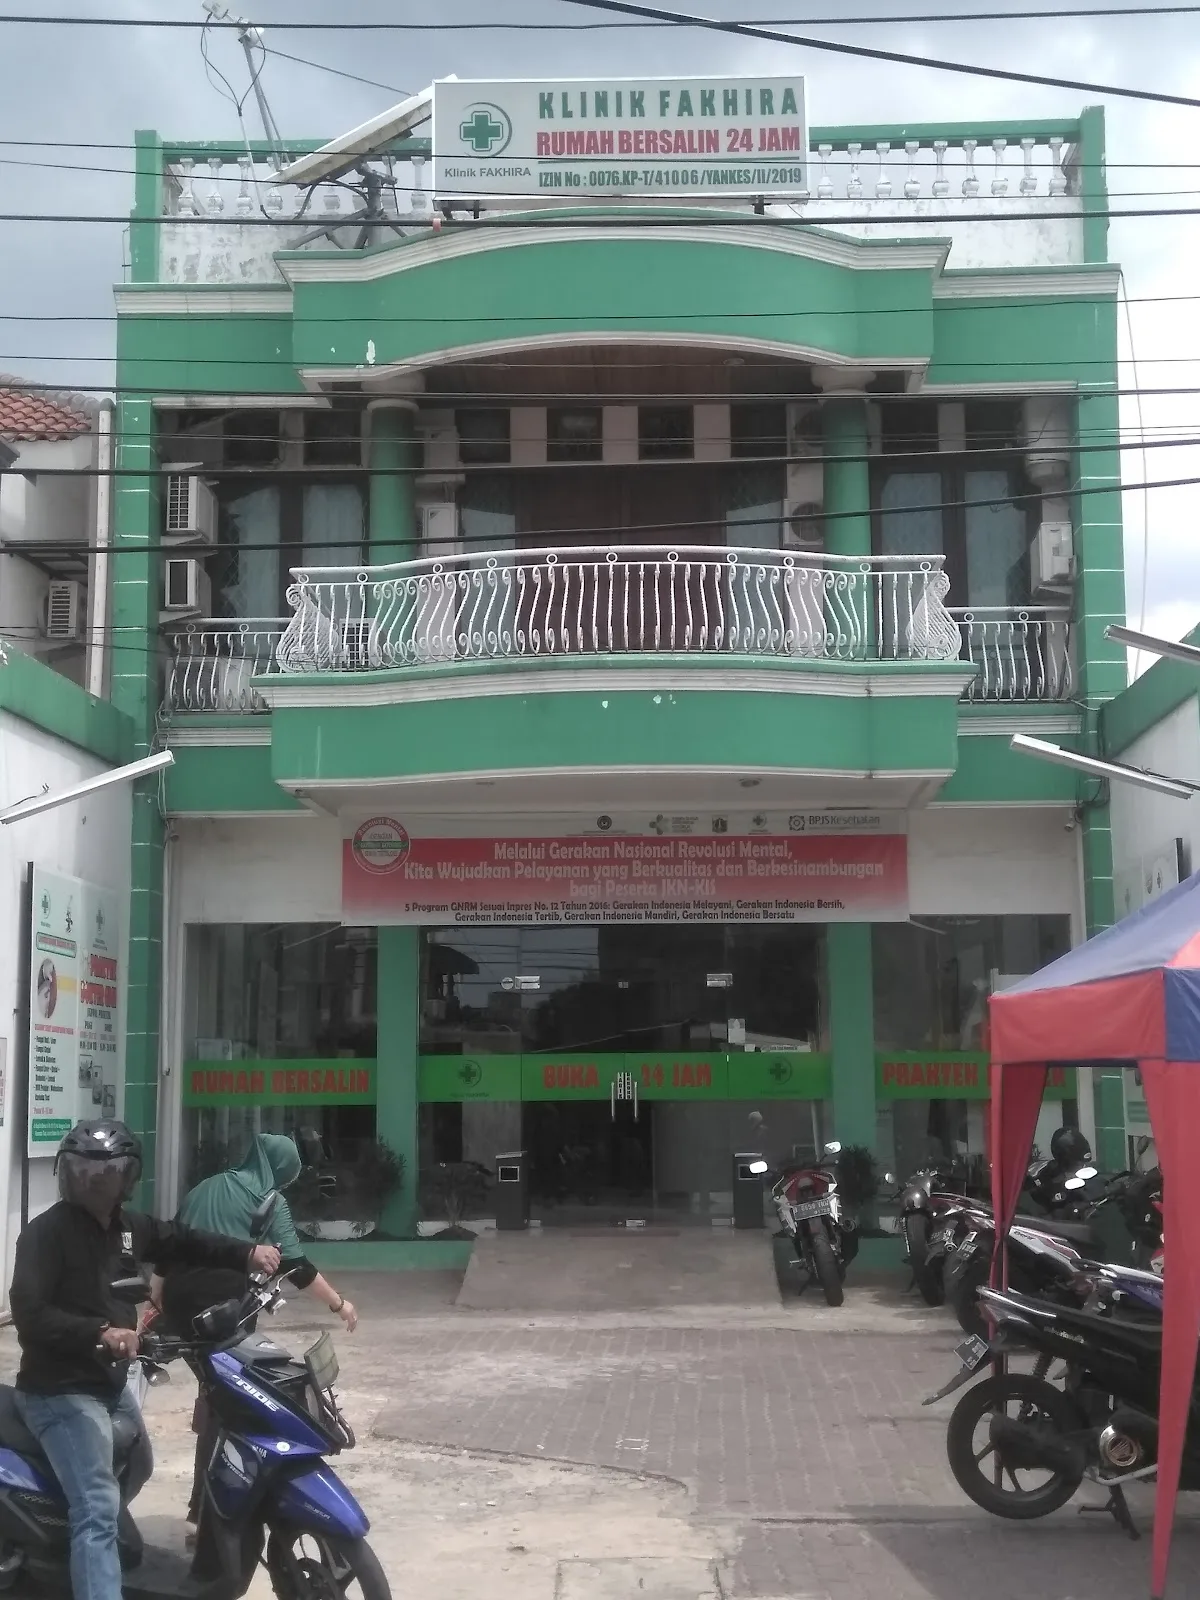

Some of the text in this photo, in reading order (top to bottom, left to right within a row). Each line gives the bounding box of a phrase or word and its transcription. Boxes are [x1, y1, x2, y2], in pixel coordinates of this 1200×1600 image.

[539, 87, 799, 119] KLINIK FAKHIRA
[537, 126, 800, 156] RUMAH BERSALIN 24 JAM
[444, 167, 532, 178] Klinik FAKHIRA
[539, 170, 562, 188] IZIN
[564, 171, 581, 187] No
[809, 815, 830, 825] BPJS
[494, 840, 793, 860] Melalui Gerakan Nasional Revolusi Mental,
[404, 859, 883, 882] Kita Wujudkan Pelayanan yang Berkualitas dan Berkesinambungan
[569, 878, 716, 898] bagi Peserta JKN-KIS
[404, 904, 410, 912] 5
[412, 902, 448, 913] Program
[450, 902, 478, 911] GNRM
[480, 902, 505, 911] Sesuai
[506, 902, 532, 912] Inpres
[534, 901, 548, 911] No.
[550, 901, 559, 910] 12
[561, 901, 587, 910] Tahun
[613, 900, 649, 910] Gerakan
[651, 900, 691, 910] Indonesia
[693, 900, 734, 911] Melayani,
[736, 899, 773, 909] Gerakan
[775, 899, 815, 909] Indonesia
[817, 899, 845, 910] Bersih,
[455, 910, 795, 922] Gerakan Indonesia Tertib, Gerakan Indonesia Mandiri, Gerakan Indonesia Bersatu
[191, 1068, 369, 1095] RUMAH BERSALIN
[543, 1062, 712, 1090] BUKA 24 JAM
[883, 1062, 978, 1087] PRAKTEK
